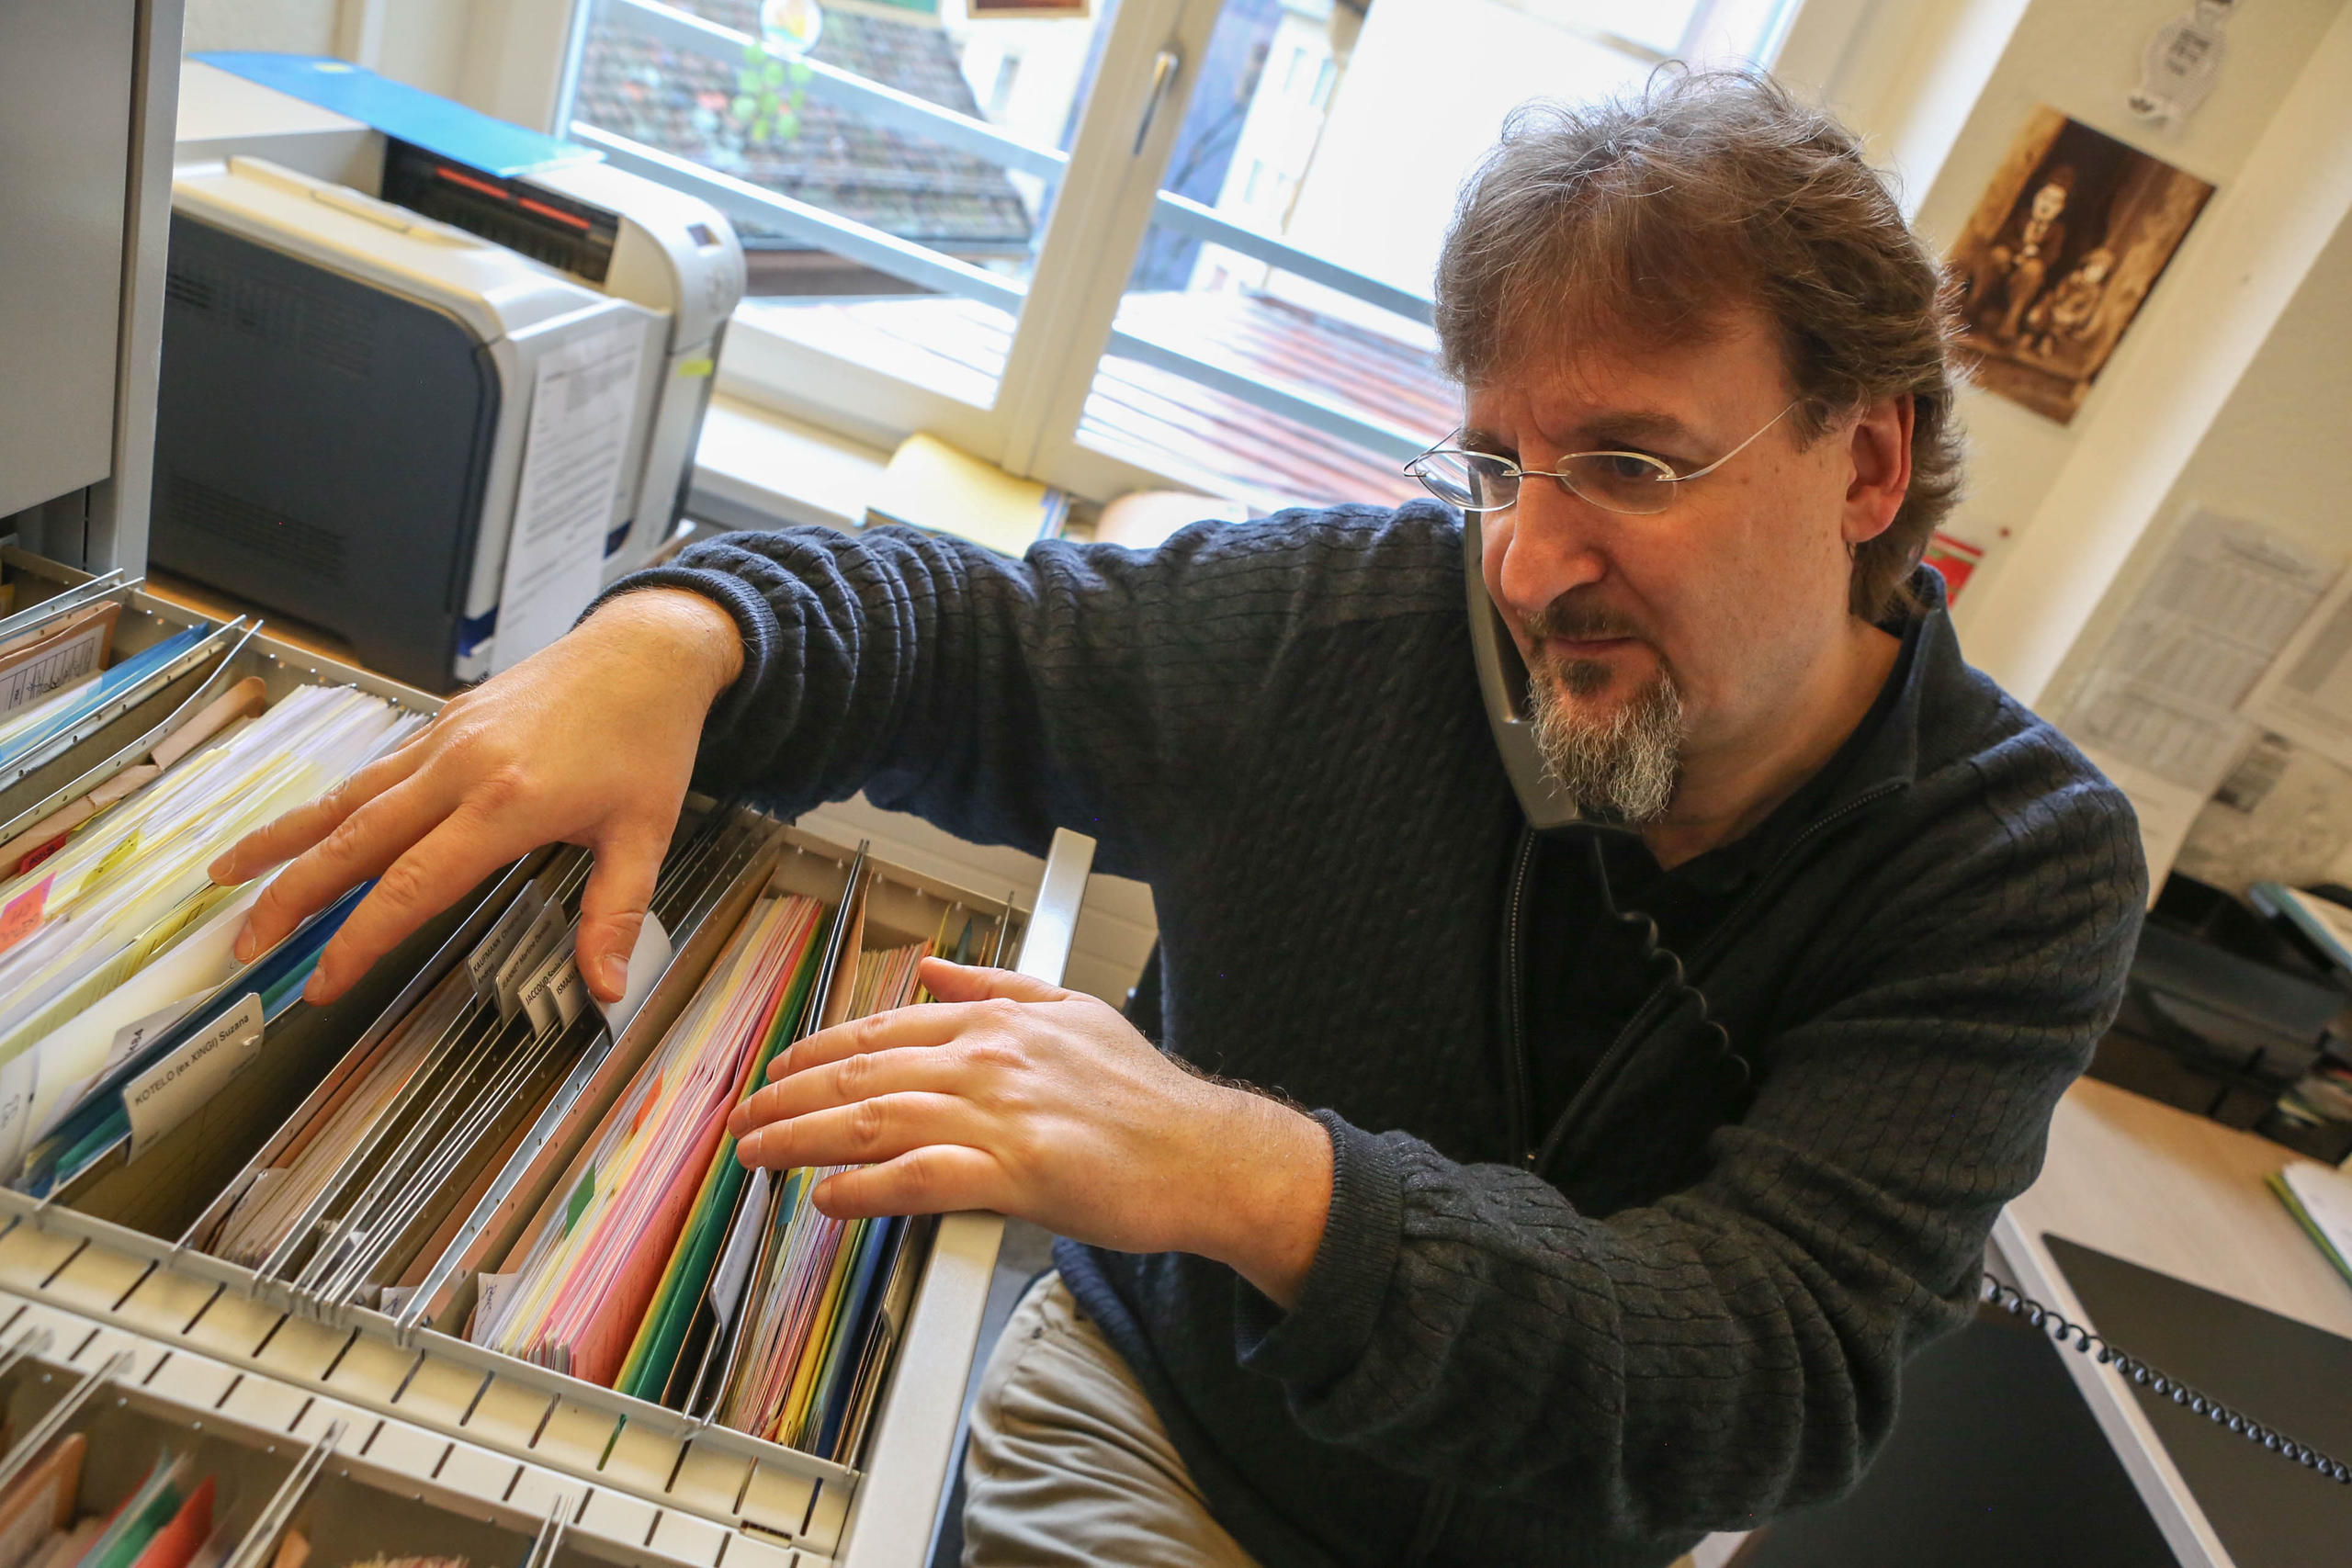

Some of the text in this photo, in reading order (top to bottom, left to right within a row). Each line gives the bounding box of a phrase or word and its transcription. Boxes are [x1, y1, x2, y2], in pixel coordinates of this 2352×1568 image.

[525, 976, 548, 1006] JACCOUD
[135, 1014, 250, 1105] KOTELO (ex XINGI) Suzana
